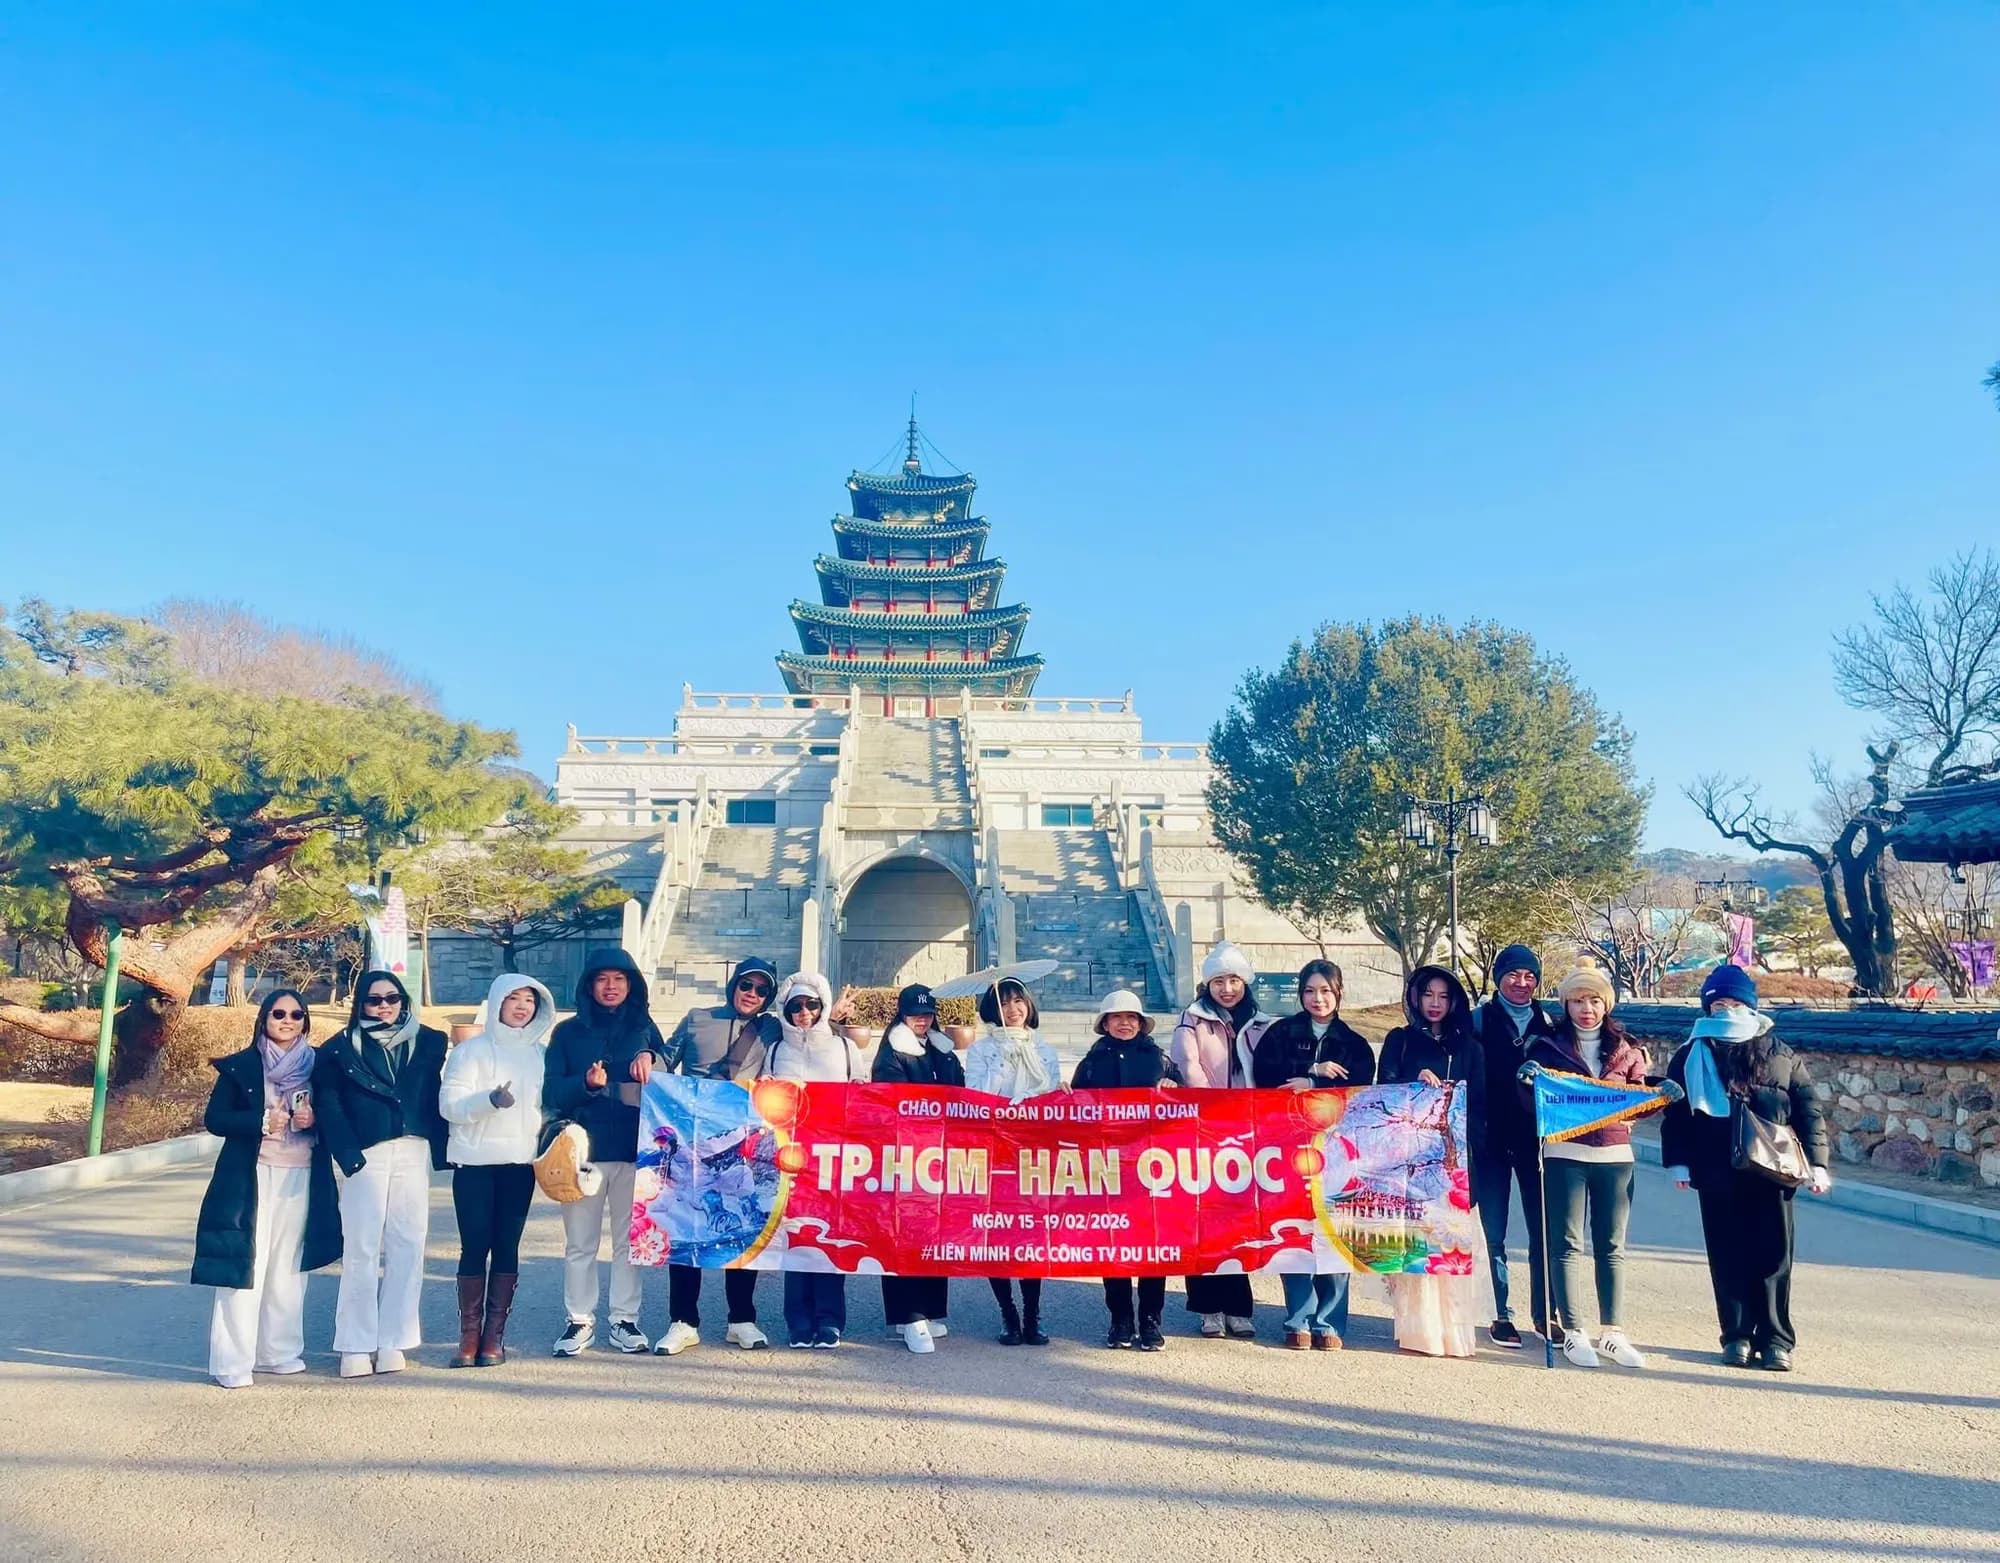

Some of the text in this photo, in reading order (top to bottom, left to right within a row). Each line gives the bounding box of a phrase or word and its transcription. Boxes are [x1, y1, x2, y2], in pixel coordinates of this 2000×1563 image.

[1567, 1094, 1591, 1104] MINH
[1043, 1105, 1065, 1120] DU
[1105, 1104, 1151, 1120] THAM
[1155, 1103, 1199, 1120] QUAN
[1136, 1131, 1286, 1198] QUỐC
[969, 1245, 1010, 1261] MINH
[1013, 1243, 1045, 1262] CÁC
[1048, 1243, 1093, 1262] CÔNG
[1120, 1246, 1142, 1262] DU
